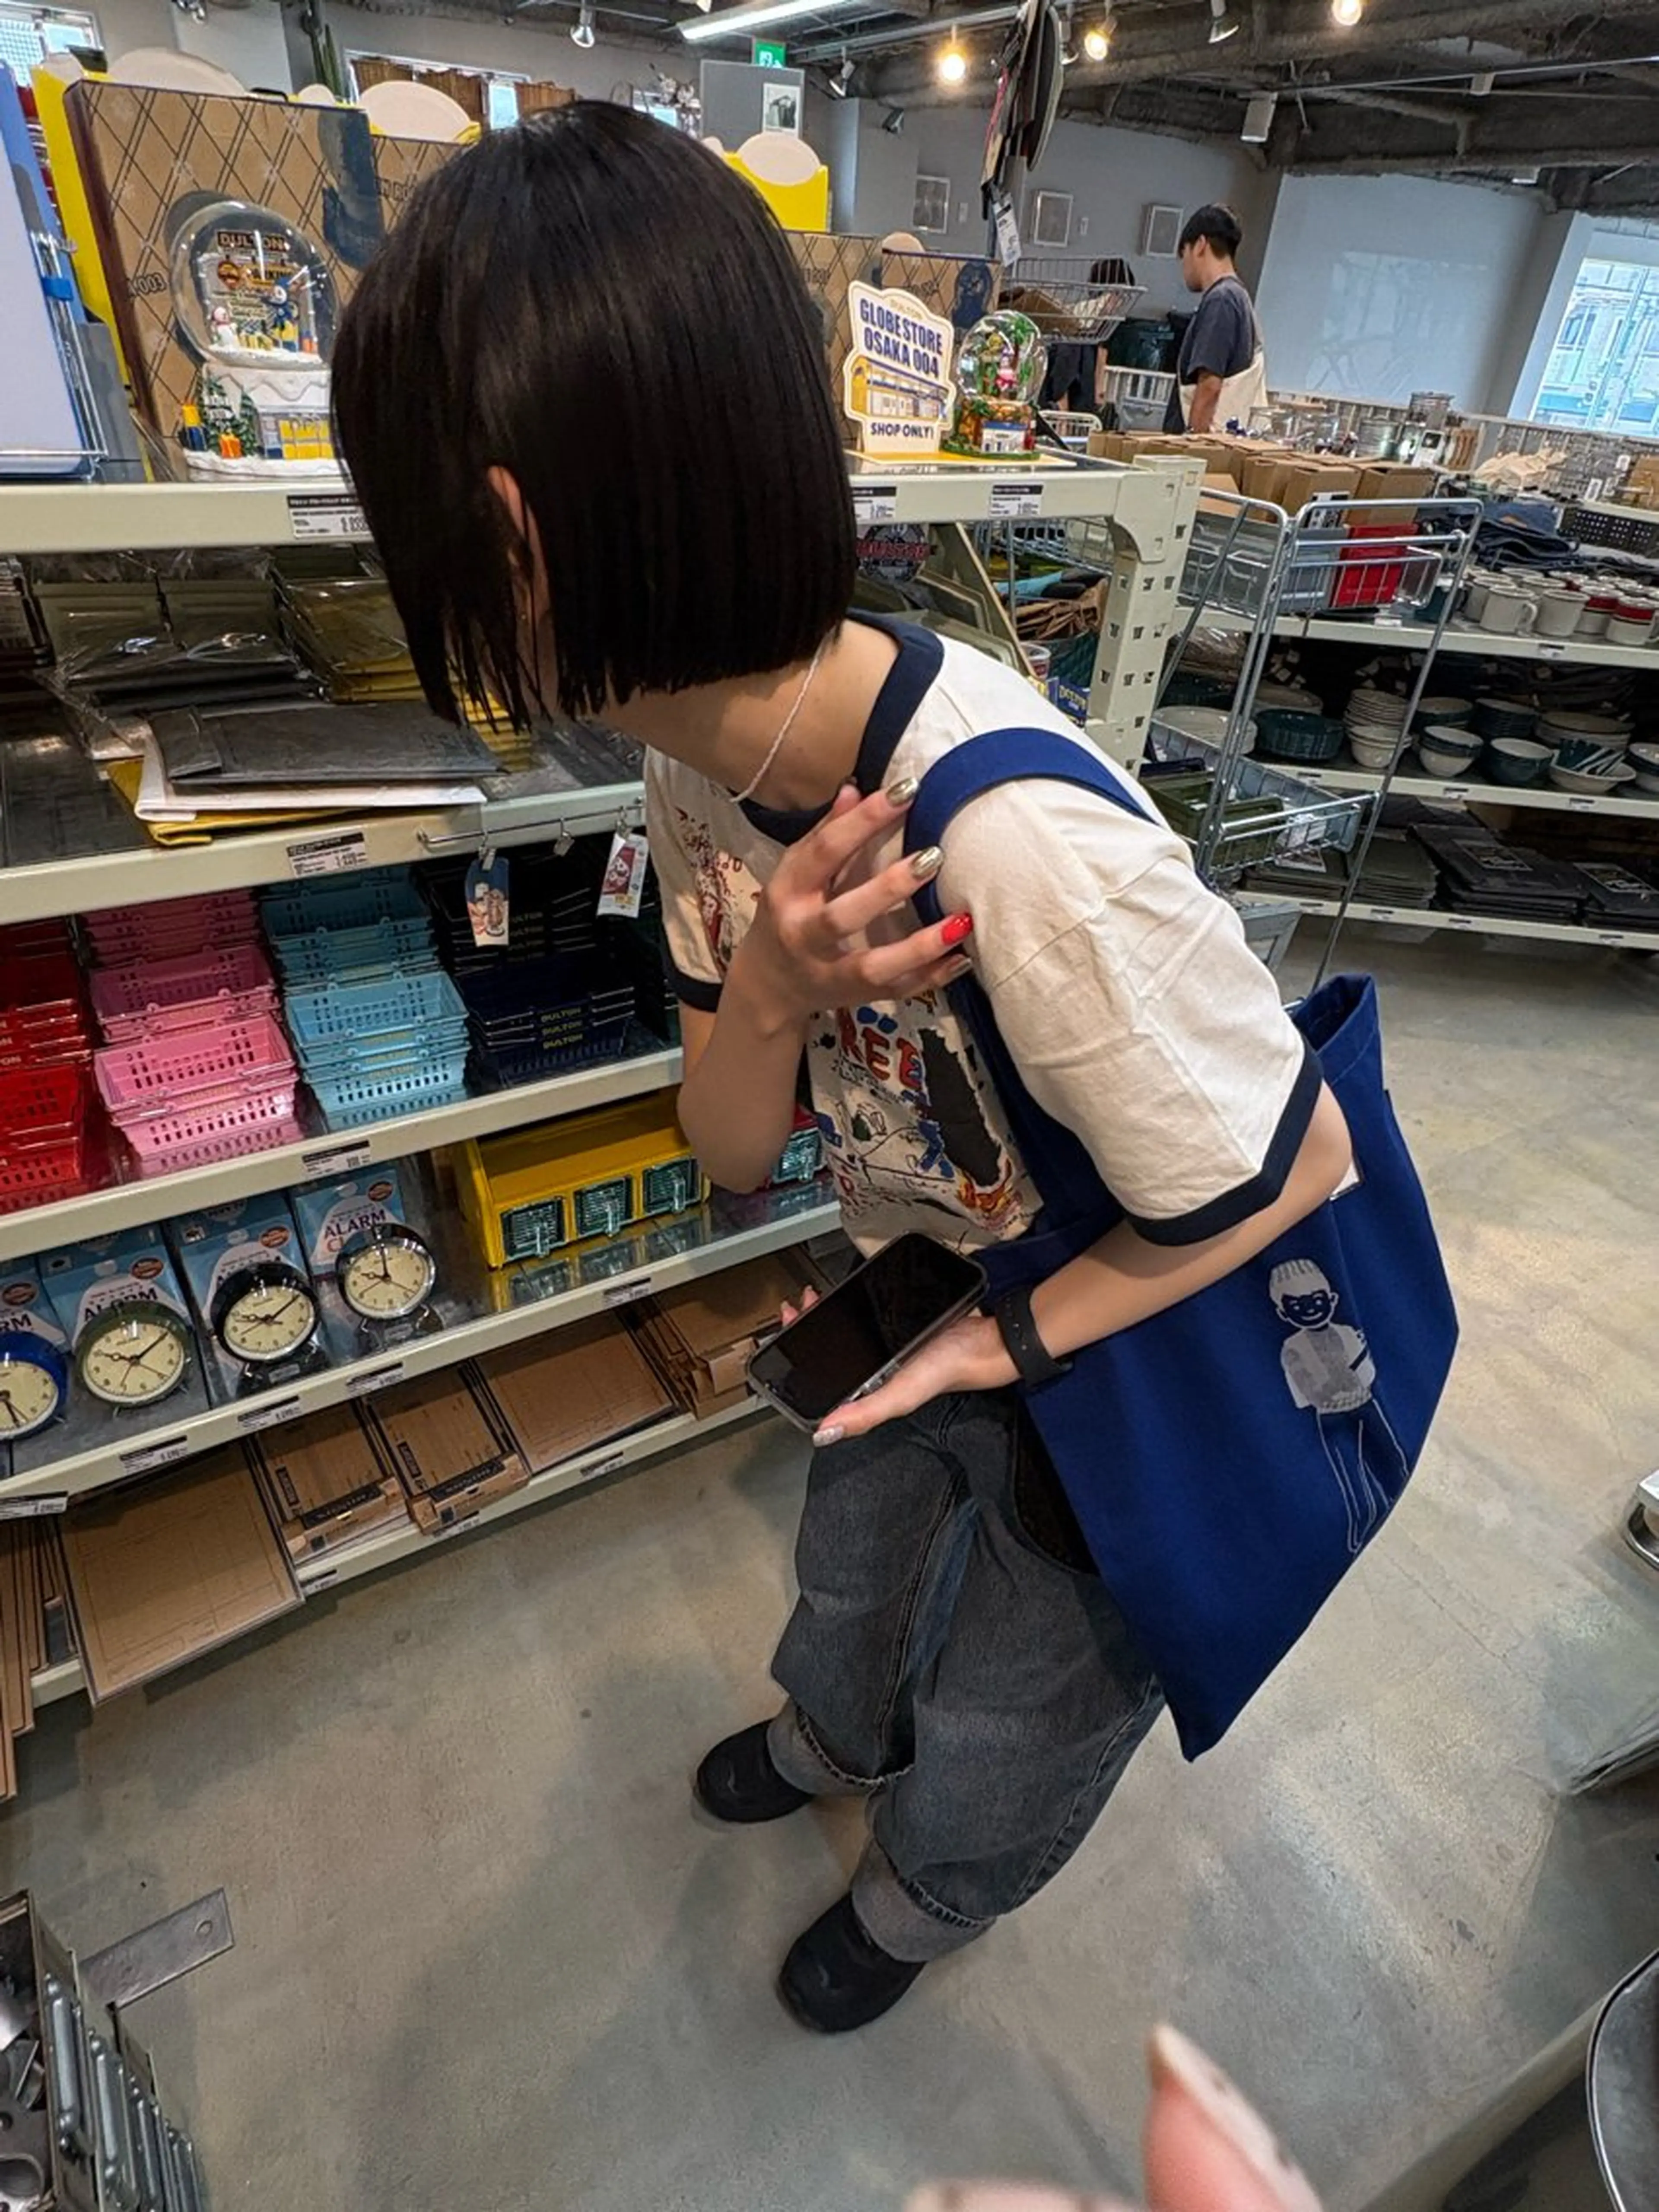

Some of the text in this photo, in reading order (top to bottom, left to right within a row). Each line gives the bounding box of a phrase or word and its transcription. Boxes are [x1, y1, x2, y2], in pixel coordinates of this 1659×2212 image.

[860, 298, 901, 338] GLOBE
[902, 317, 943, 356] STORE
[864, 327, 939, 378] OSAKA 004
[871, 423, 900, 437] SHOP
[324, 1209, 386, 1239] ALARM
